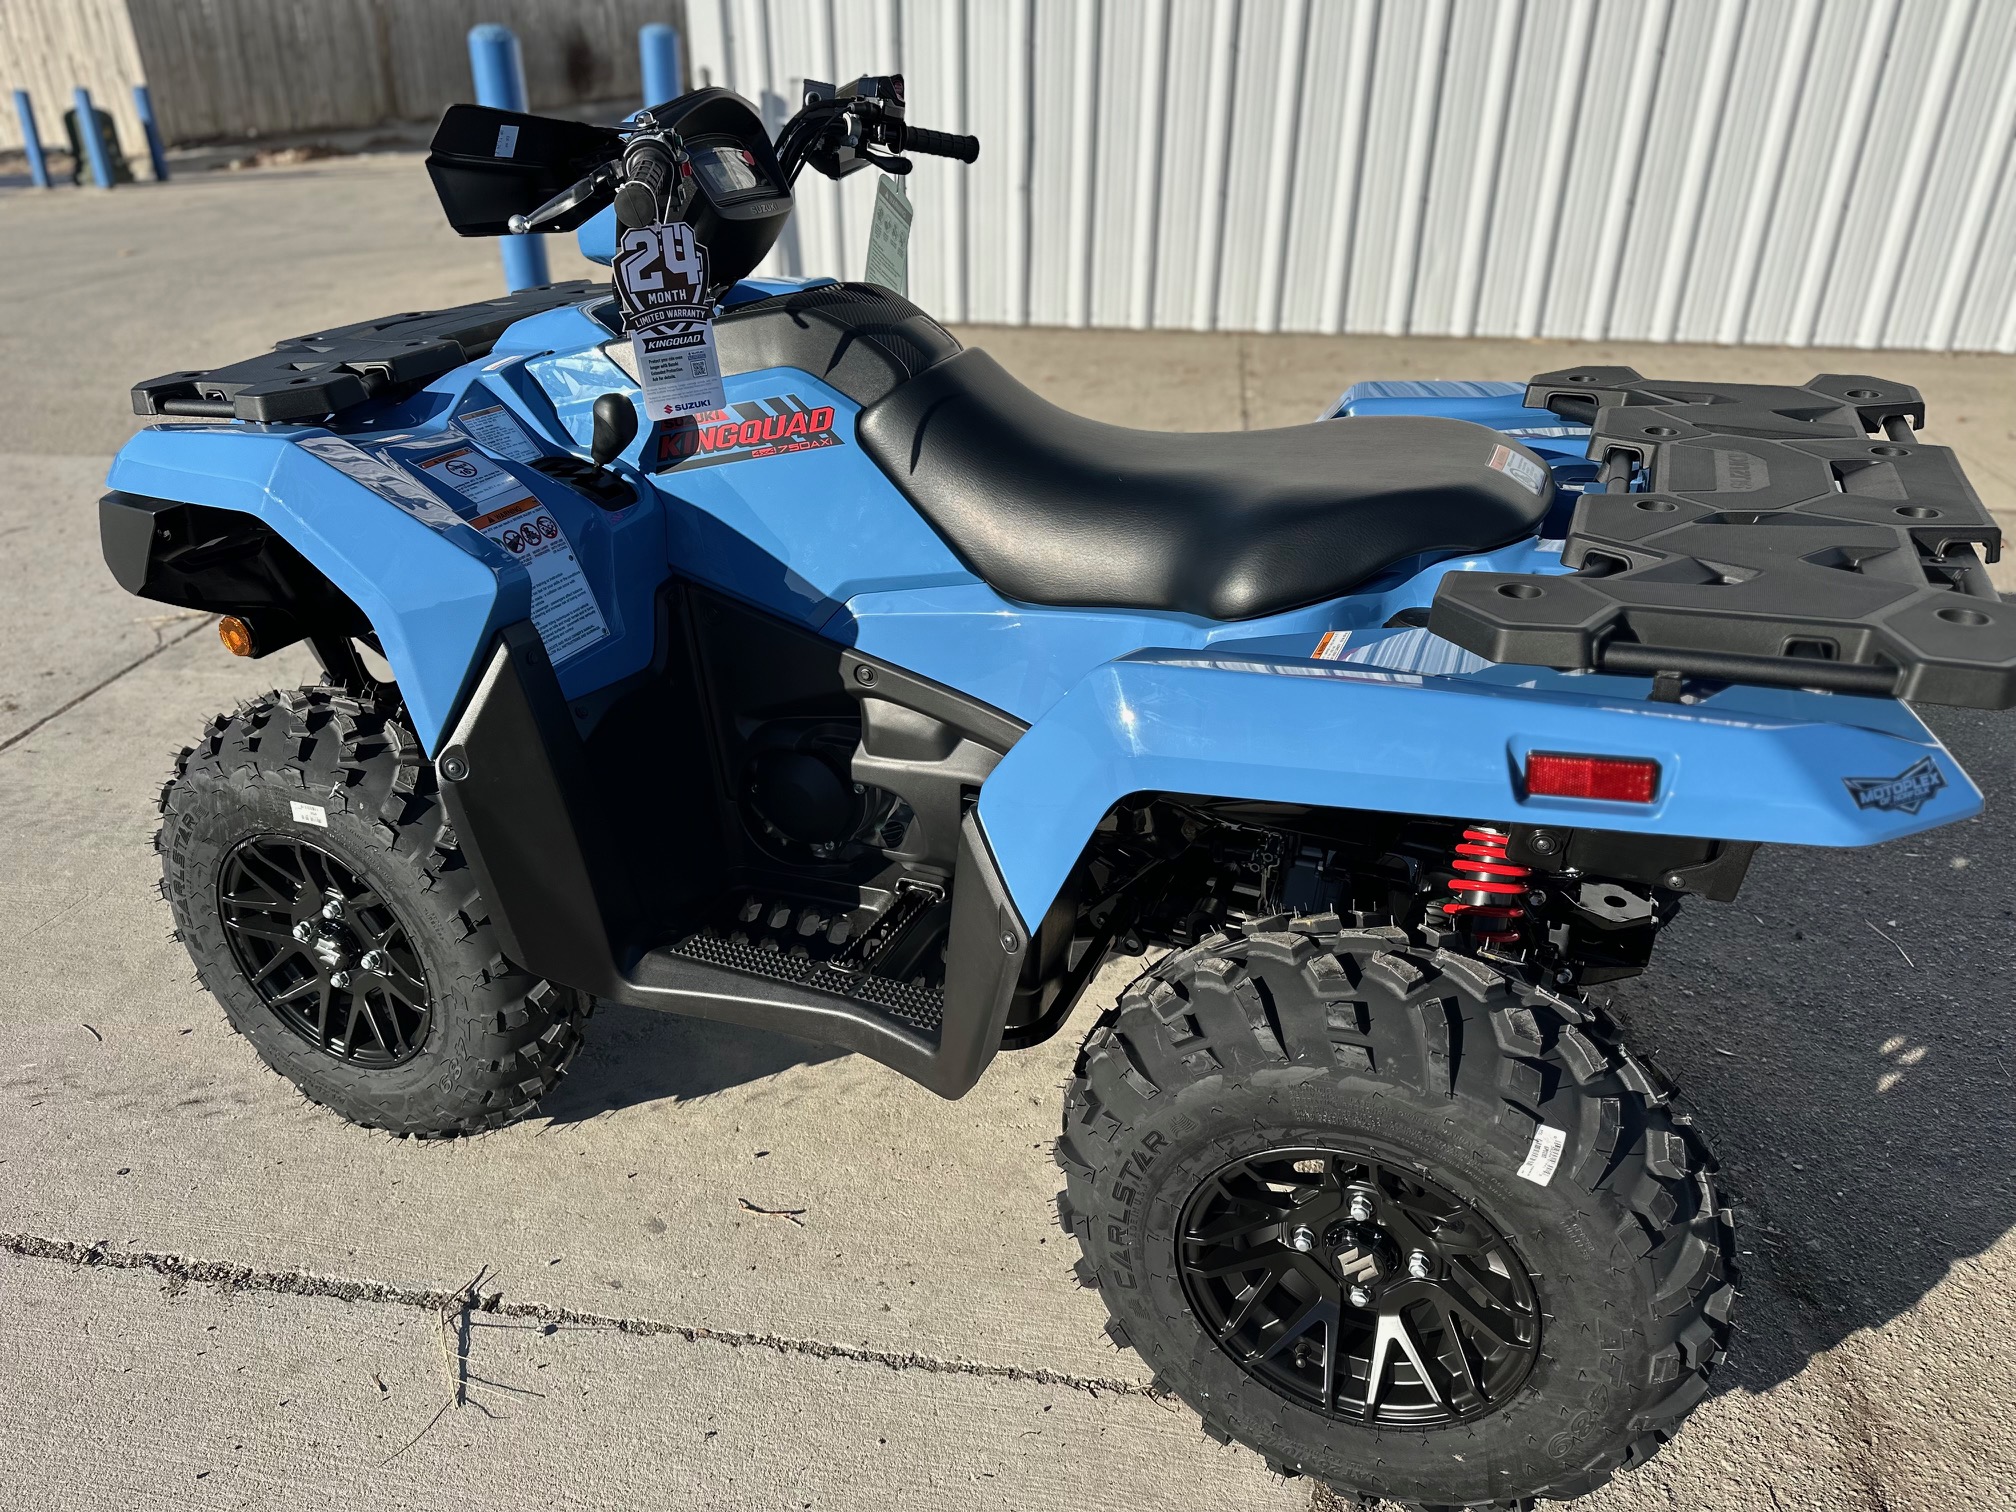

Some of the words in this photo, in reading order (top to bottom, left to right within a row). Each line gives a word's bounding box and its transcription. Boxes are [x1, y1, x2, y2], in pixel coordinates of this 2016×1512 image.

[750, 203, 778, 214] SUZUKI
[623, 223, 702, 292] 24
[648, 288, 687, 305] MONTH
[635, 310, 665, 328] LIMITED
[666, 308, 706, 321] WARRANTY
[648, 334, 701, 350] KINGQUAD
[674, 400, 711, 411] SUZUKI
[659, 408, 834, 458] KINGQUAD
[778, 438, 833, 453] 750AXi
[1860, 772, 1940, 804] MOTOPLEX
[1108, 1129, 1173, 1290] CARLSTAR
